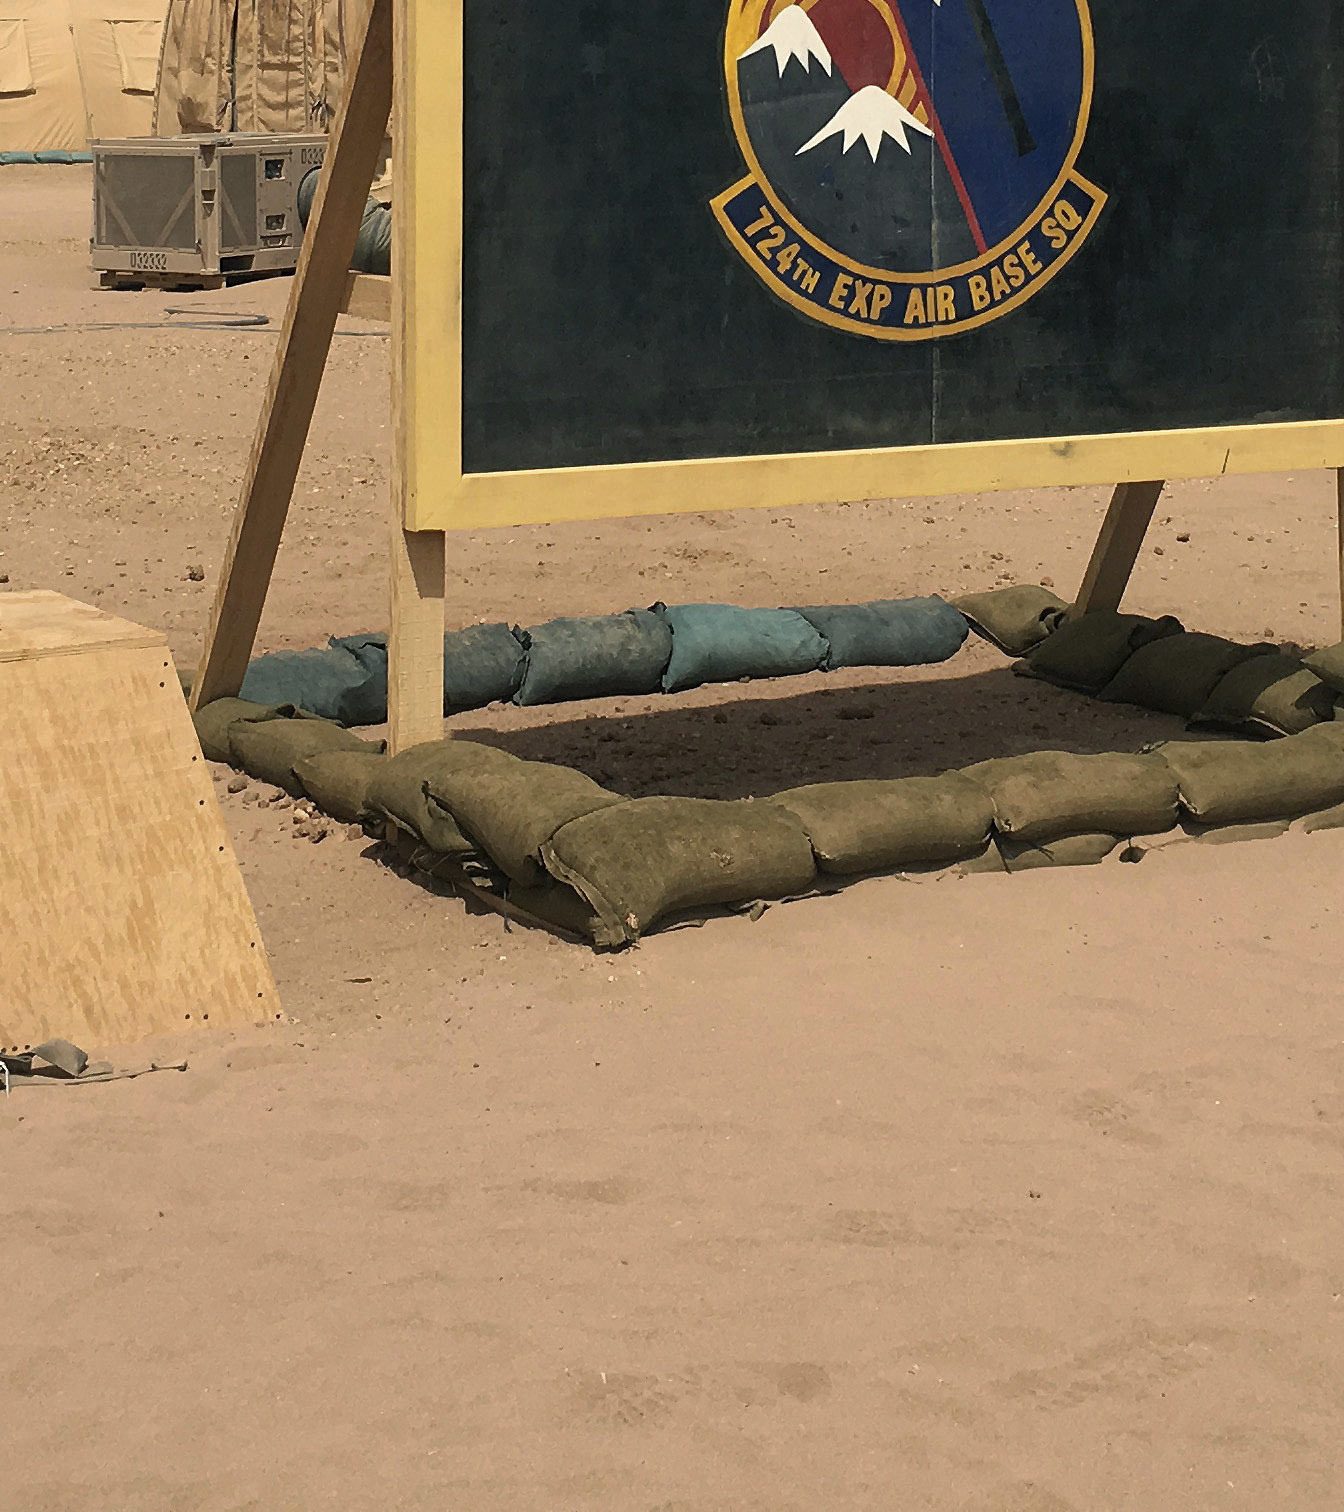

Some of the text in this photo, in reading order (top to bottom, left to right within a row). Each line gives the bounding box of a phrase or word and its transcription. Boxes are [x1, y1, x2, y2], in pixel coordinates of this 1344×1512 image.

[744, 202, 1083, 325] 724TH EXP AIR BASE SQ
